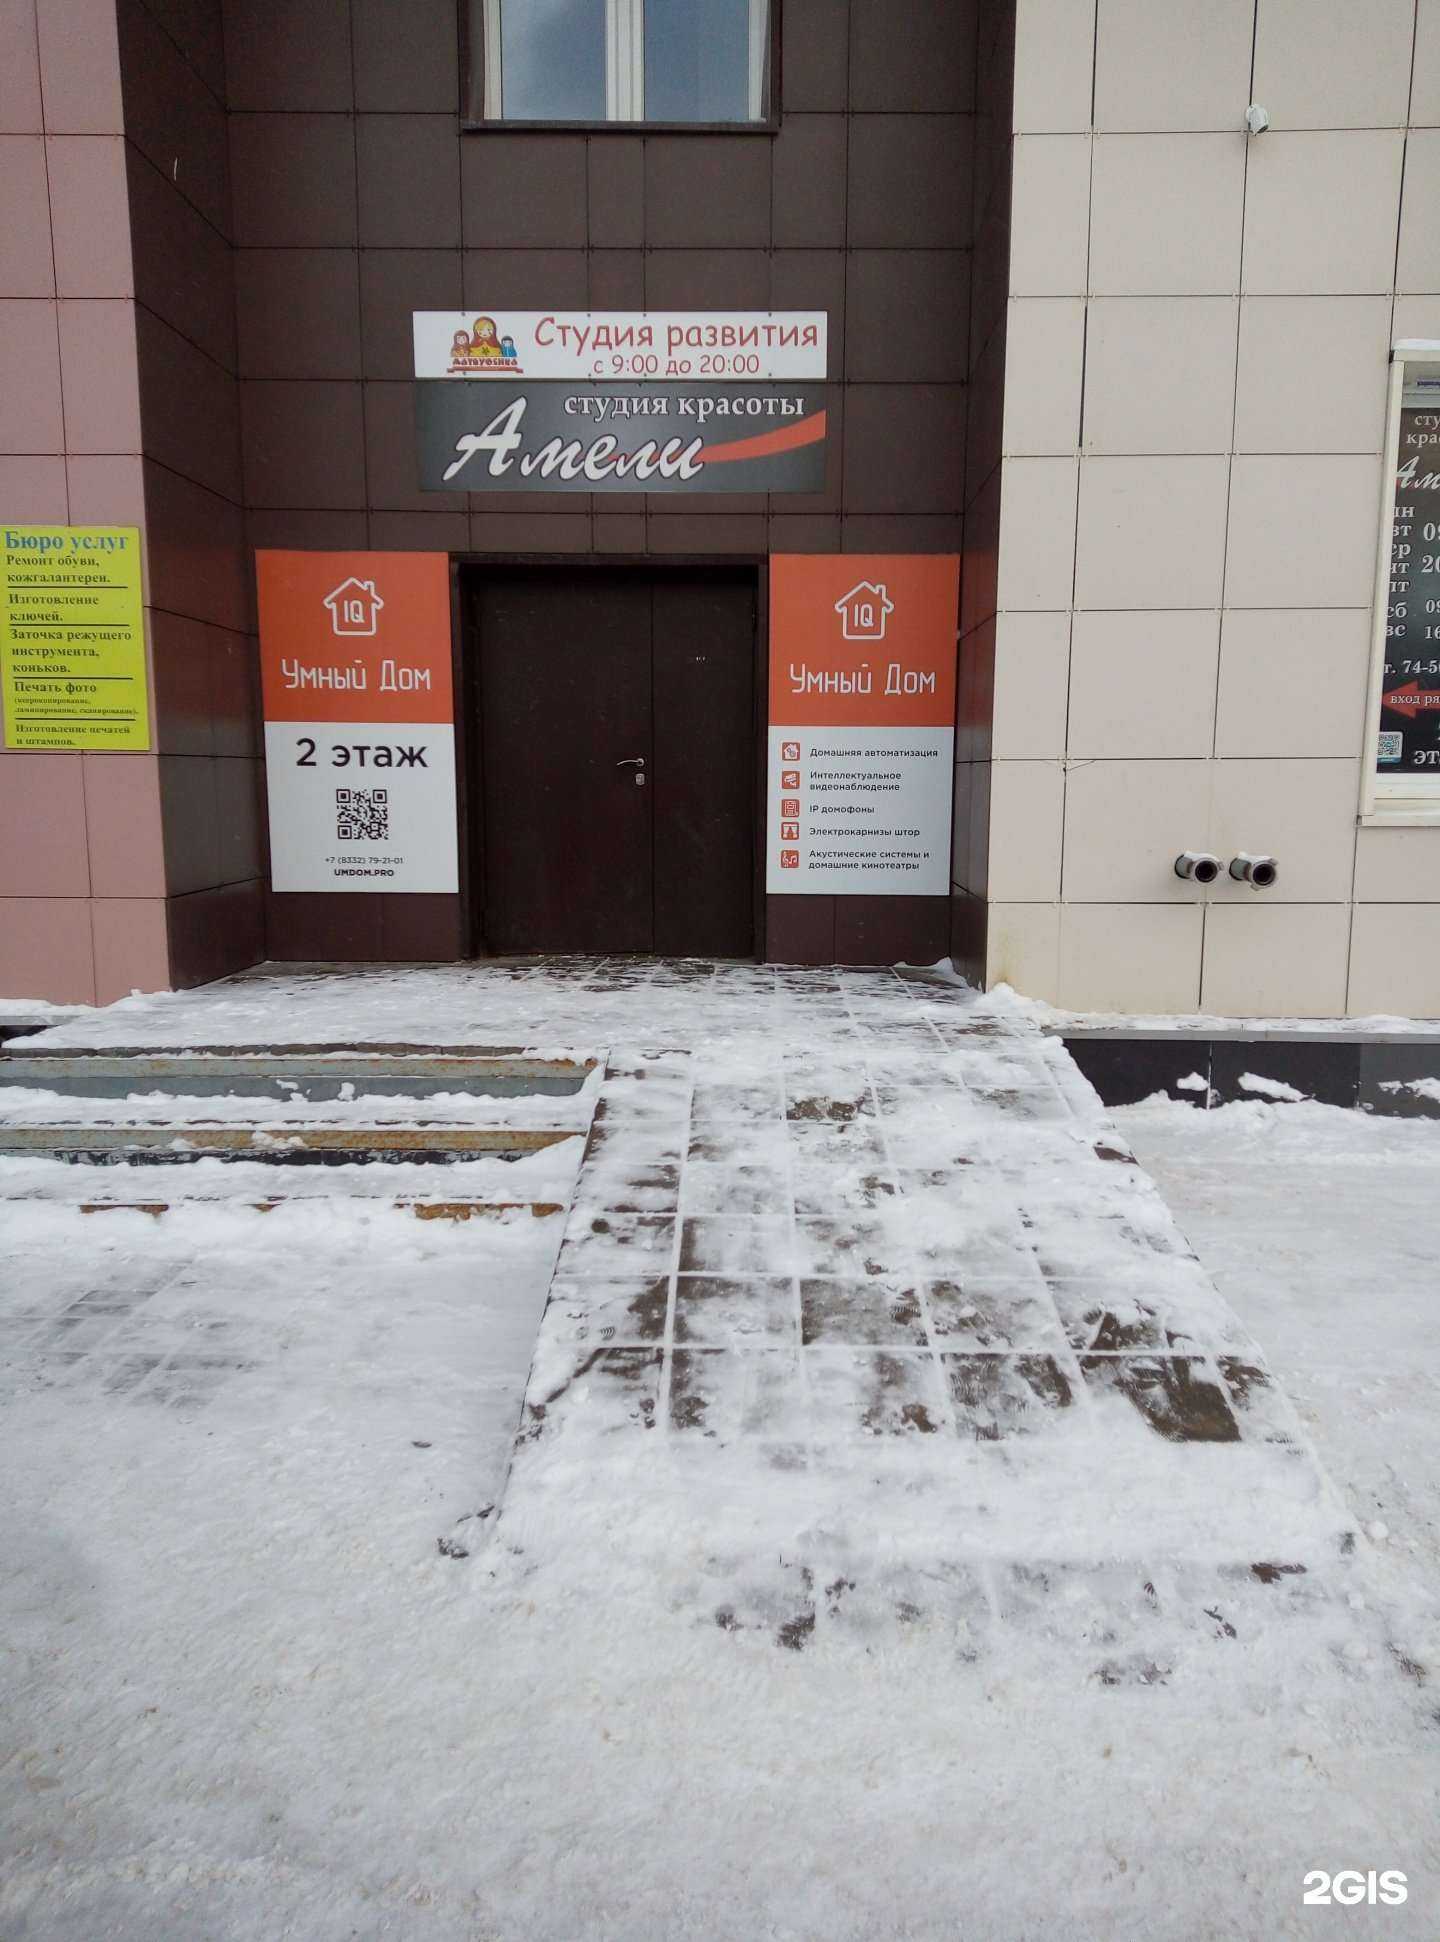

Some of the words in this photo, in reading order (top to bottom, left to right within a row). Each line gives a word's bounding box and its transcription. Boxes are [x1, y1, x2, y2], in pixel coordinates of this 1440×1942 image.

[534, 317, 654, 356] Студия
[667, 322, 818, 355] развития
[593, 361, 604, 374] с
[611, 355, 658, 374] 9:00
[666, 360, 691, 375] до
[699, 354, 760, 374] 20:00
[564, 395, 668, 423] студия
[677, 396, 805, 423] красоты
[442, 396, 705, 482] Амели
[1406, 433, 1440, 448] кра
[5, 530, 64, 553] Бюро
[70, 535, 129, 554] услуг
[6, 554, 54, 567] Ремонт
[57, 555, 100, 568] обуви,
[9, 593, 100, 606] Изготовление
[9, 610, 64, 622] ключей.
[343, 600, 365, 624] IQ
[853, 603, 875, 628] IQ
[10, 628, 64, 641] Заточка
[66, 631, 132, 643] режущего
[12, 648, 100, 658] инструмента,
[12, 664, 71, 674] коньков.
[1402, 660, 1440, 675] 74-5
[281, 658, 367, 690] Умный
[379, 659, 432, 693] Дом
[789, 663, 873, 694] Умный
[884, 663, 937, 696] Дом
[14, 681, 62, 693] Печать
[65, 680, 97, 697] фото
[1390, 695, 1421, 705] вход
[16, 724, 87, 734] Изготовление
[89, 725, 131, 734] печатей
[16, 738, 23, 746] и
[25, 738, 77, 747] штампов.
[295, 737, 317, 767] 2
[331, 744, 429, 768] этаж
[809, 747, 863, 758] Домашняя
[864, 748, 939, 758] автоматизация
[809, 770, 902, 782] Интеллектуальное
[809, 781, 901, 793] видеонаблюдение
[809, 804, 819, 814] IP
[820, 804, 876, 816] домофоны
[809, 826, 893, 838] Электрокарнизы
[894, 827, 921, 838] штор
[324, 856, 336, 865] +7
[808, 848, 876, 860] Акустические
[878, 849, 921, 859] системы
[923, 850, 930, 859] и
[808, 860, 860, 871] домашние
[861, 860, 920, 871] кинотеатры
[333, 868, 395, 877] UMDOM.PRO
